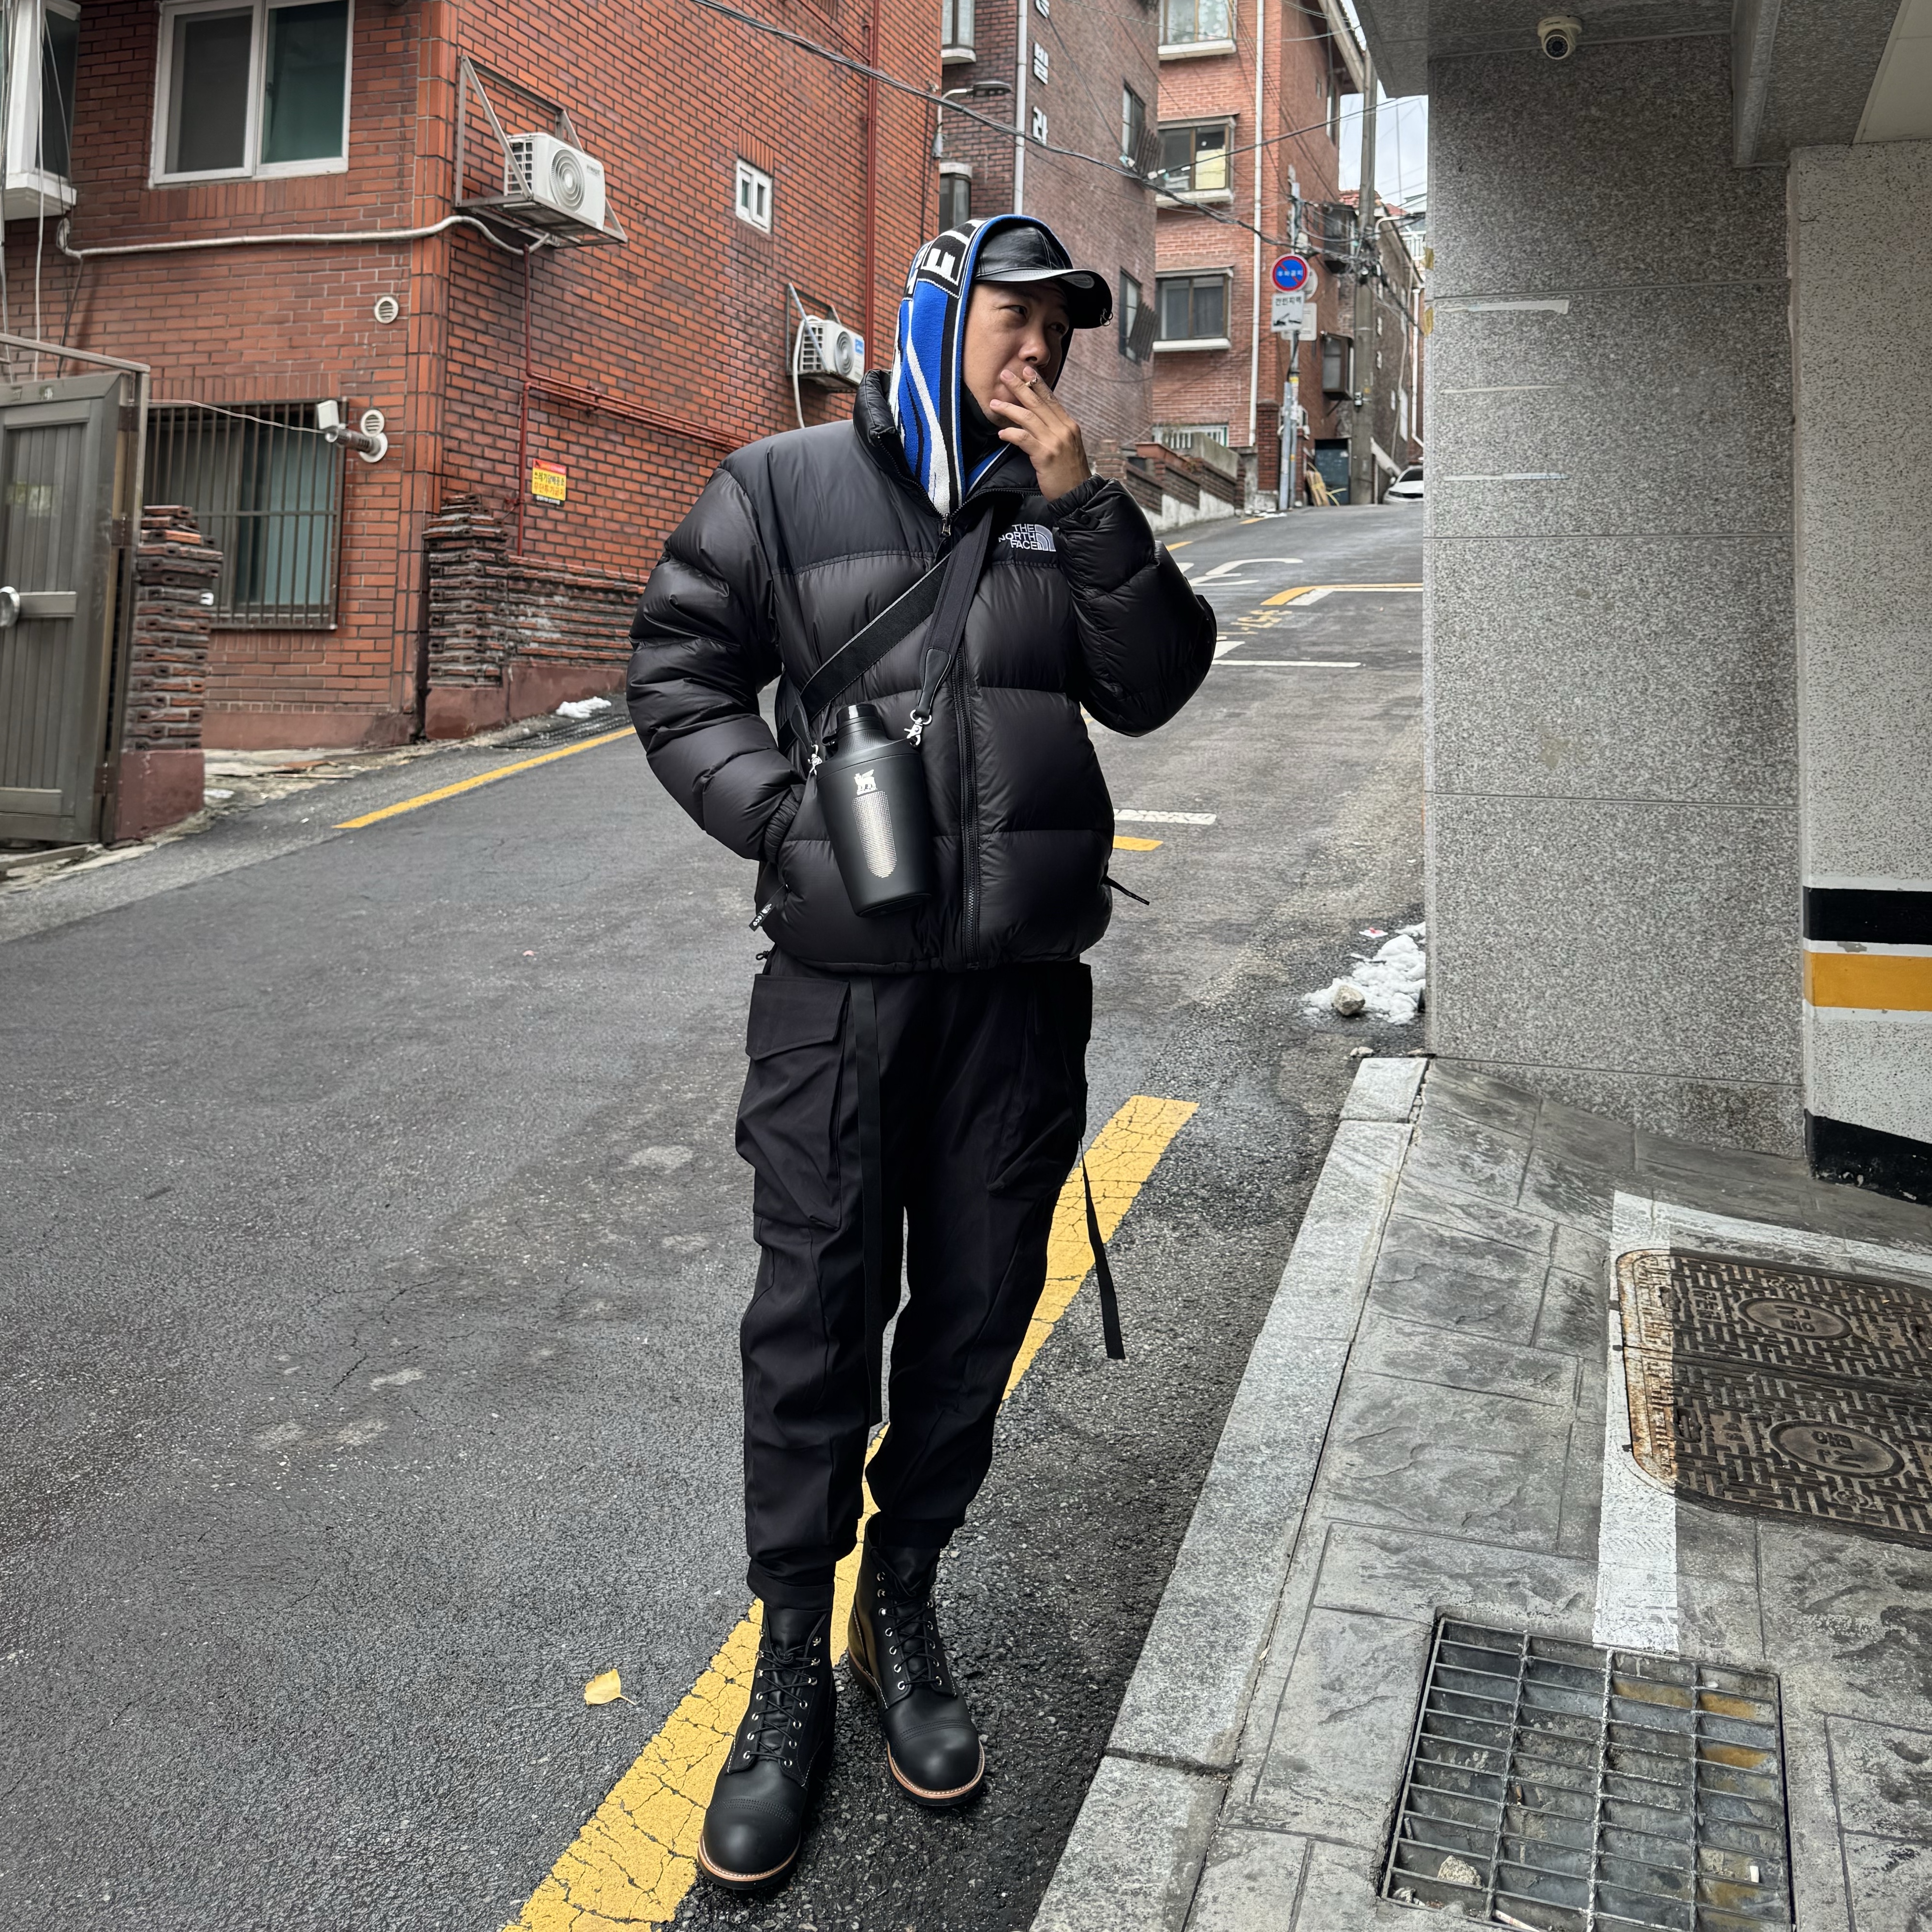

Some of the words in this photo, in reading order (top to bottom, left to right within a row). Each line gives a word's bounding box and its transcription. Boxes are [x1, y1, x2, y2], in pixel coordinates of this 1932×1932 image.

[1275, 296, 1302, 306] 견인지역
[1012, 524, 1034, 532] THE
[998, 531, 1036, 543] NORTH
[1010, 540, 1038, 550] FACE
